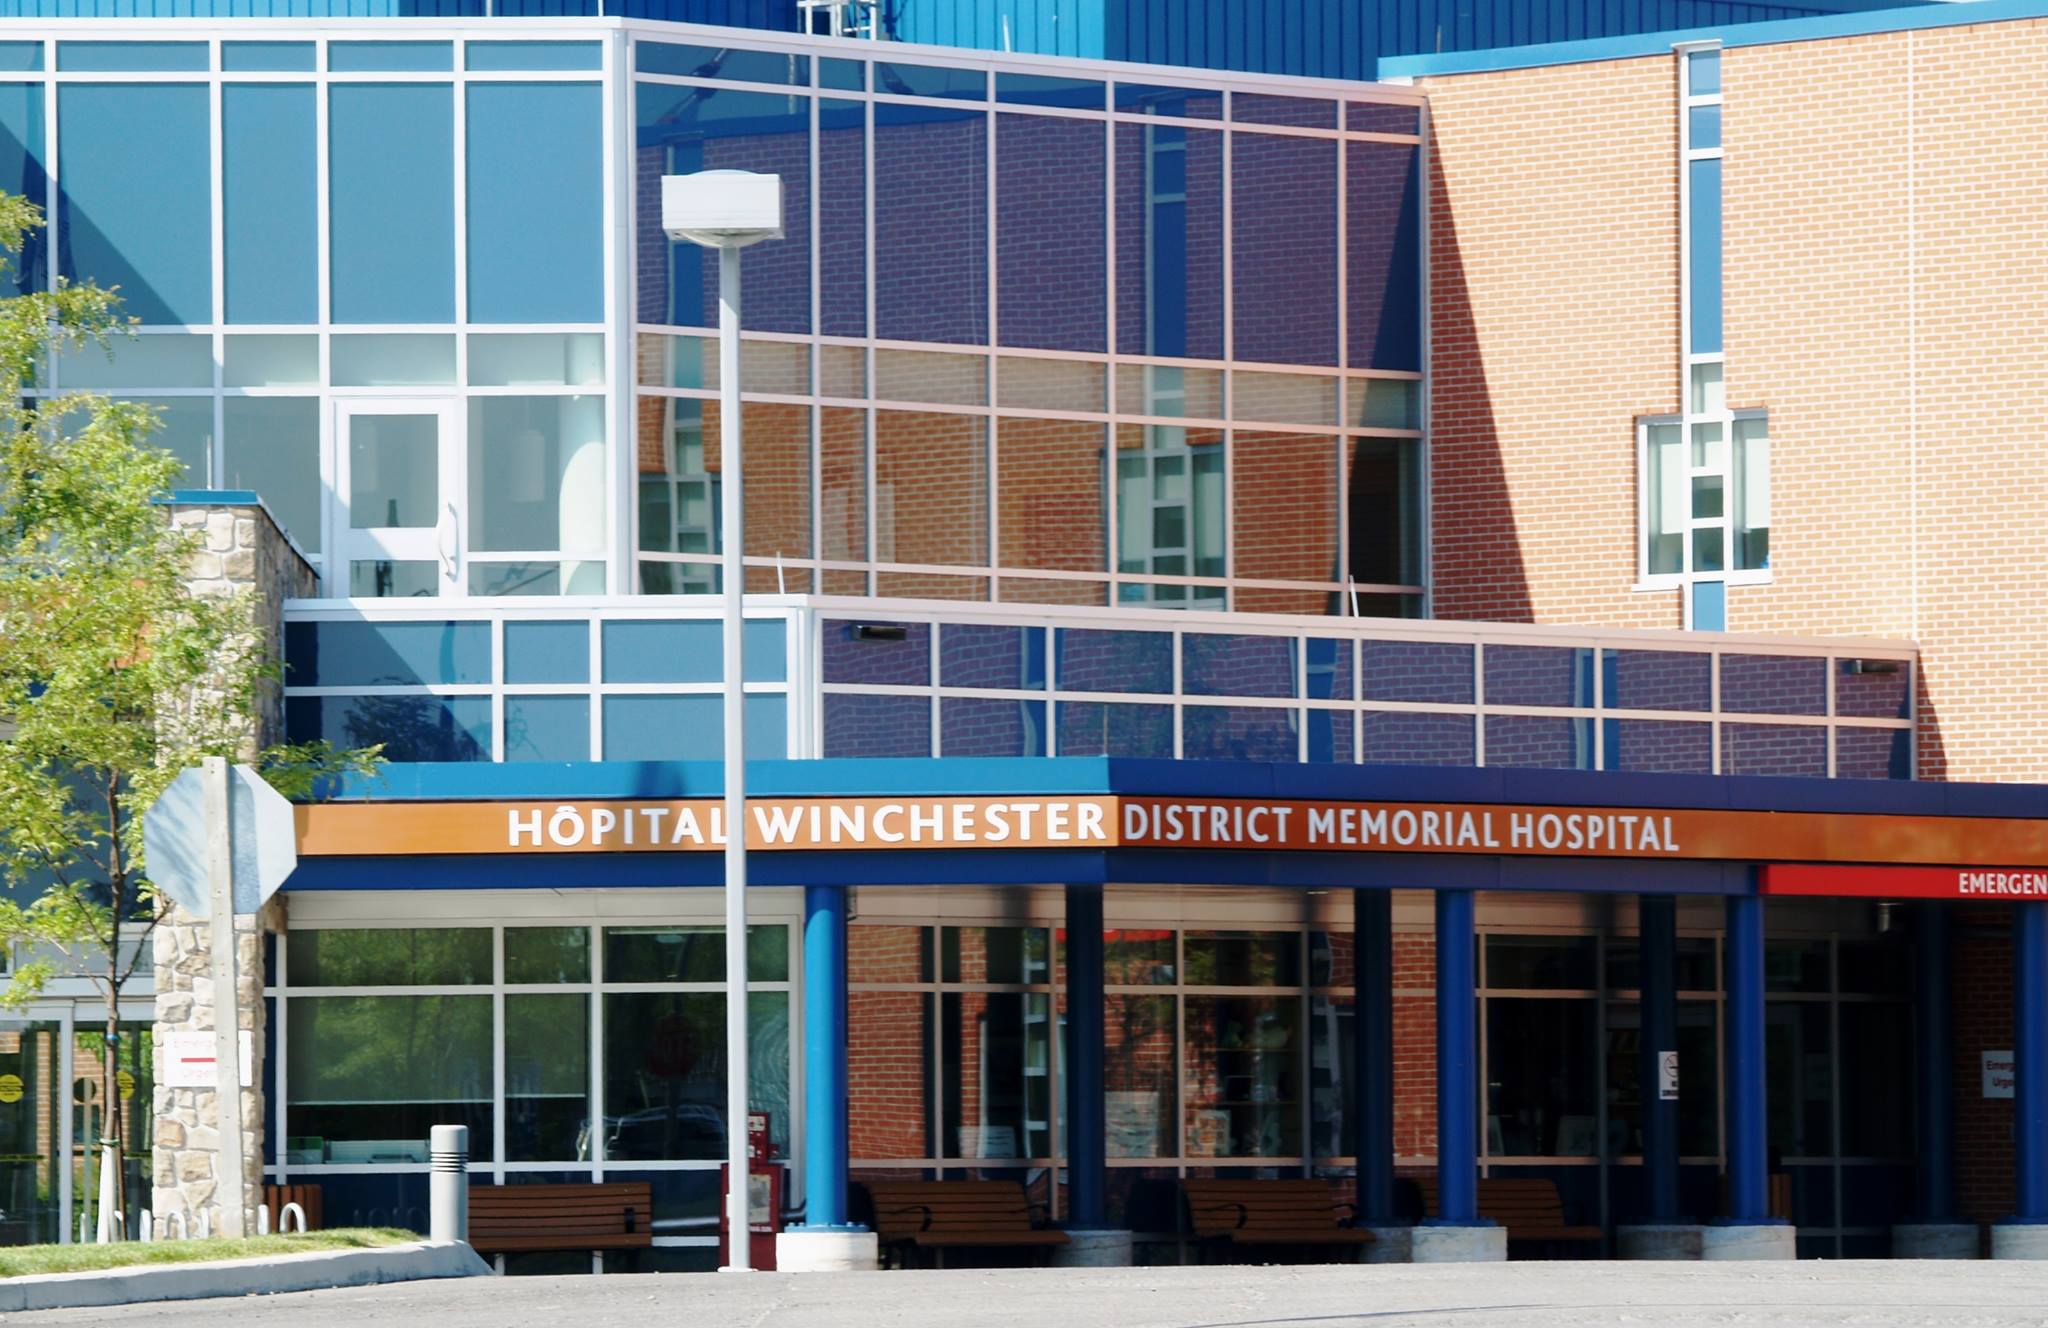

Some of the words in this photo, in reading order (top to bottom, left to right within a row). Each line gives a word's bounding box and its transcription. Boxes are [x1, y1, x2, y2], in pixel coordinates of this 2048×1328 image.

[508, 805, 726, 846] HÔPITAL
[752, 803, 1107, 843] WINCHESTER
[1124, 804, 1293, 843] DISTRICT
[1307, 808, 1500, 847] MEMORIAL
[1510, 813, 1680, 852] HOSPITAL
[1959, 872, 2048, 895] EMERGEN
